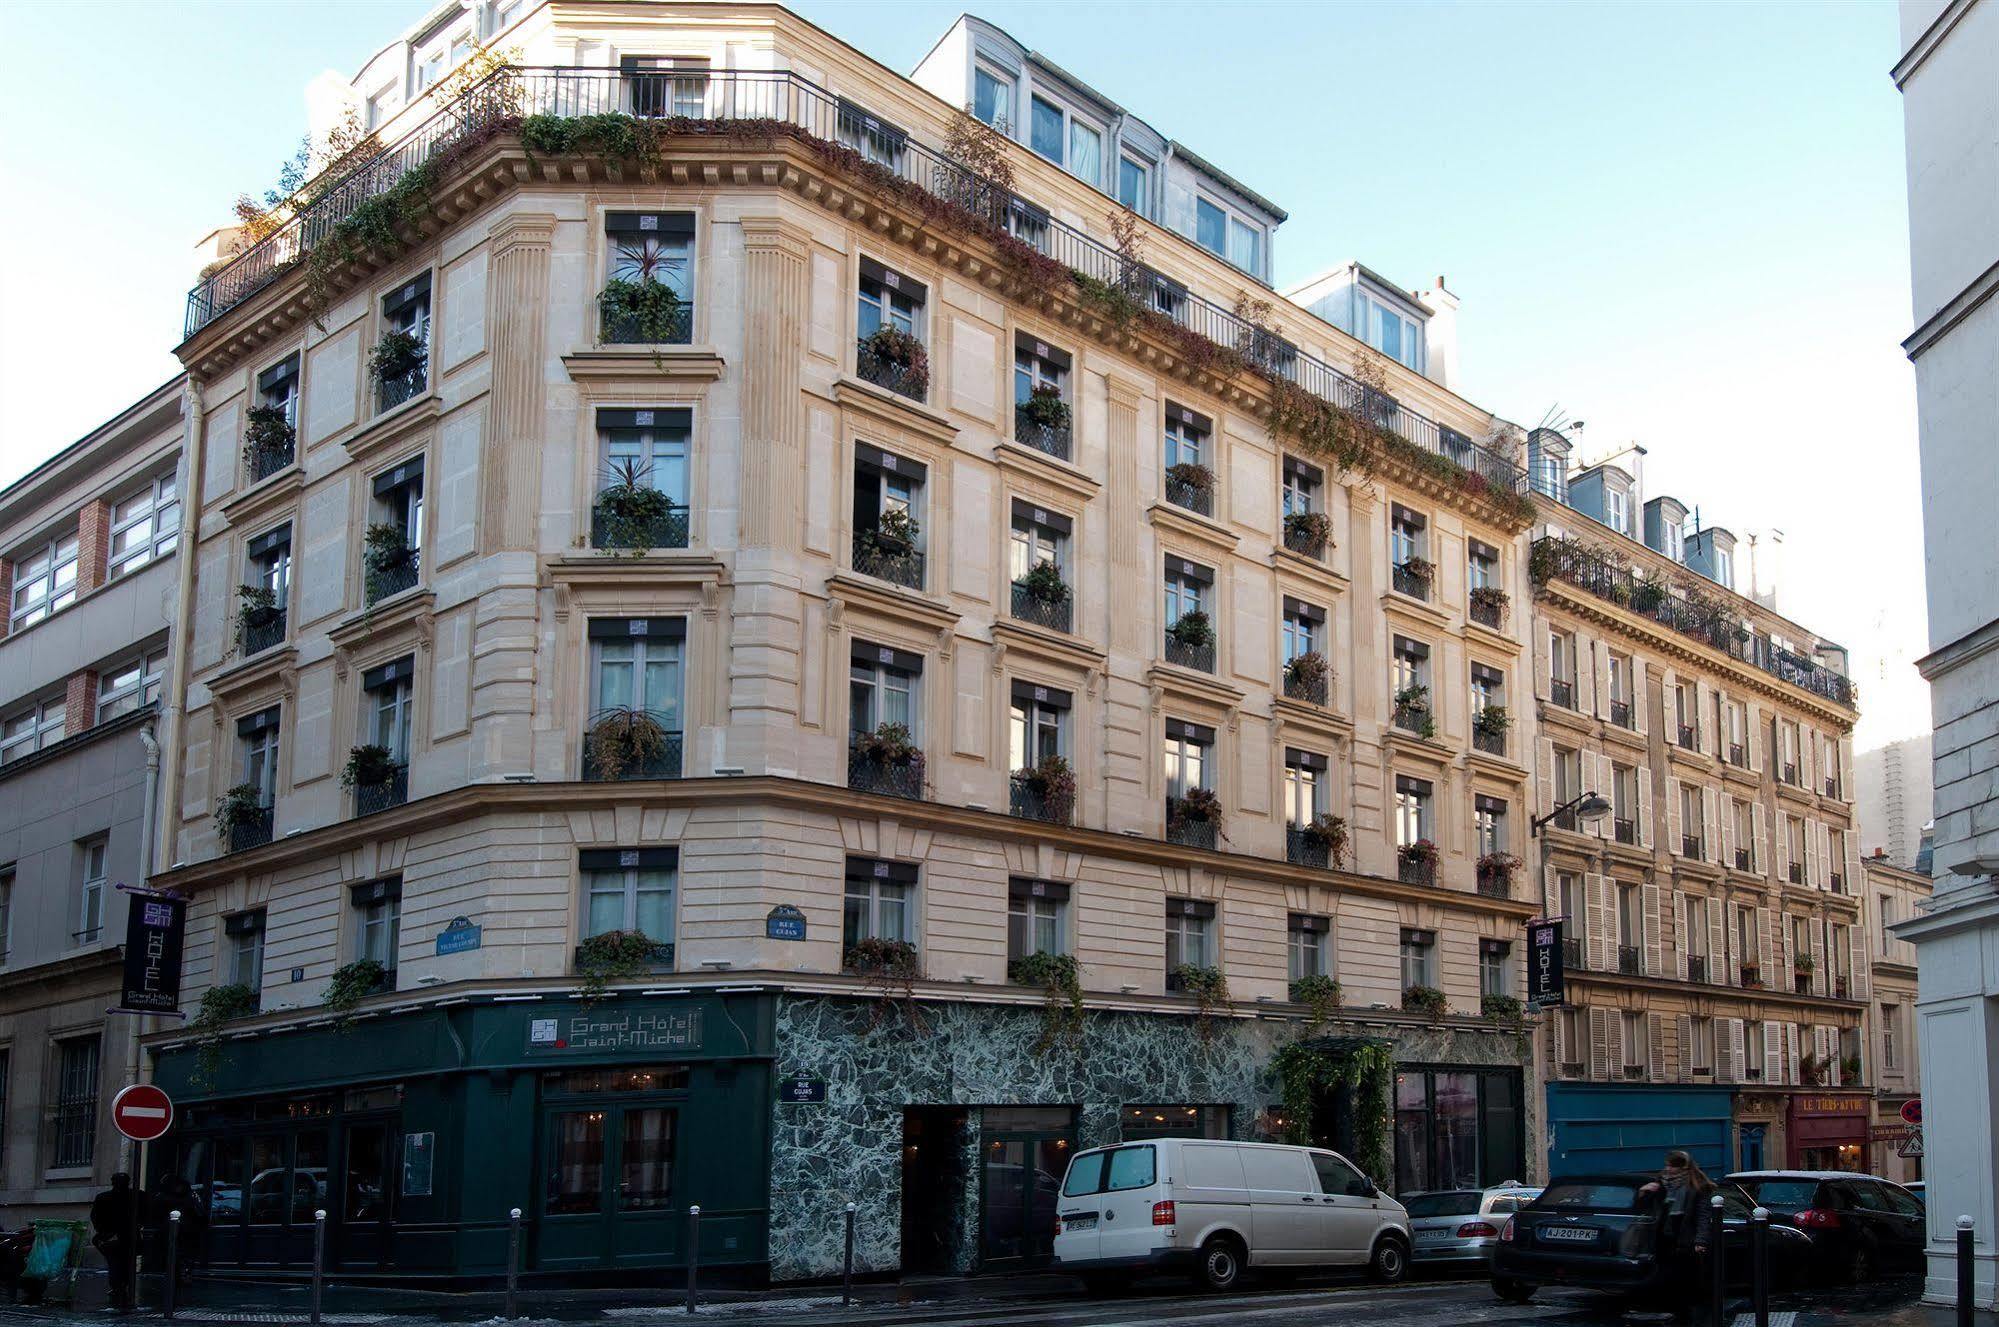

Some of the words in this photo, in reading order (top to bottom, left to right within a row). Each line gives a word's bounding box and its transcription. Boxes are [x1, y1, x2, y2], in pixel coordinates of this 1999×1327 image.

[570, 1015, 629, 1033] Grand
[638, 1013, 693, 1031] Hôtel
[569, 1029, 693, 1048] Saint-Michel
[1803, 1099, 1813, 1110] LE
